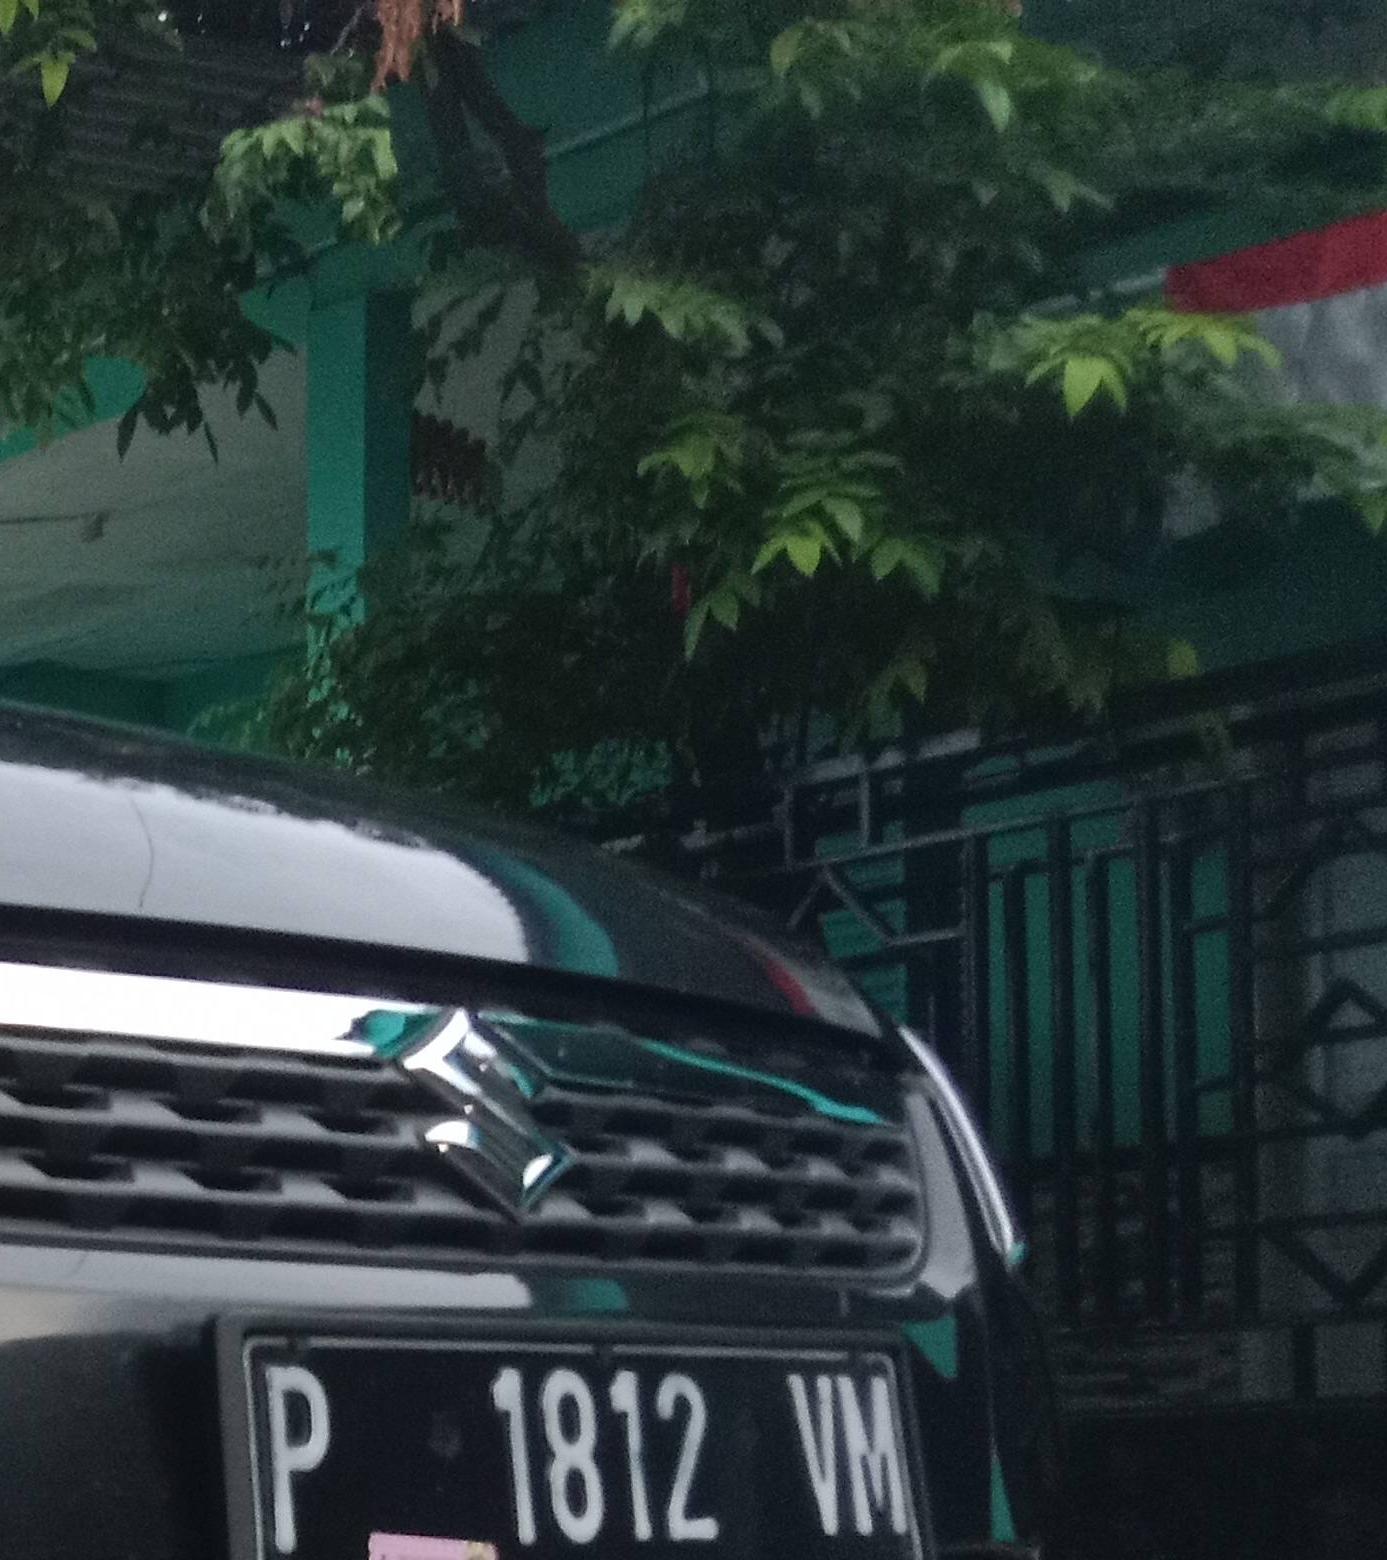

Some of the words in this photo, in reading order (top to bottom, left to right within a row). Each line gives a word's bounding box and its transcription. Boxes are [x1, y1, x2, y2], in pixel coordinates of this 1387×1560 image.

[264, 1364, 331, 1554] P
[491, 1366, 720, 1546] 1812
[787, 1373, 911, 1537] VM
